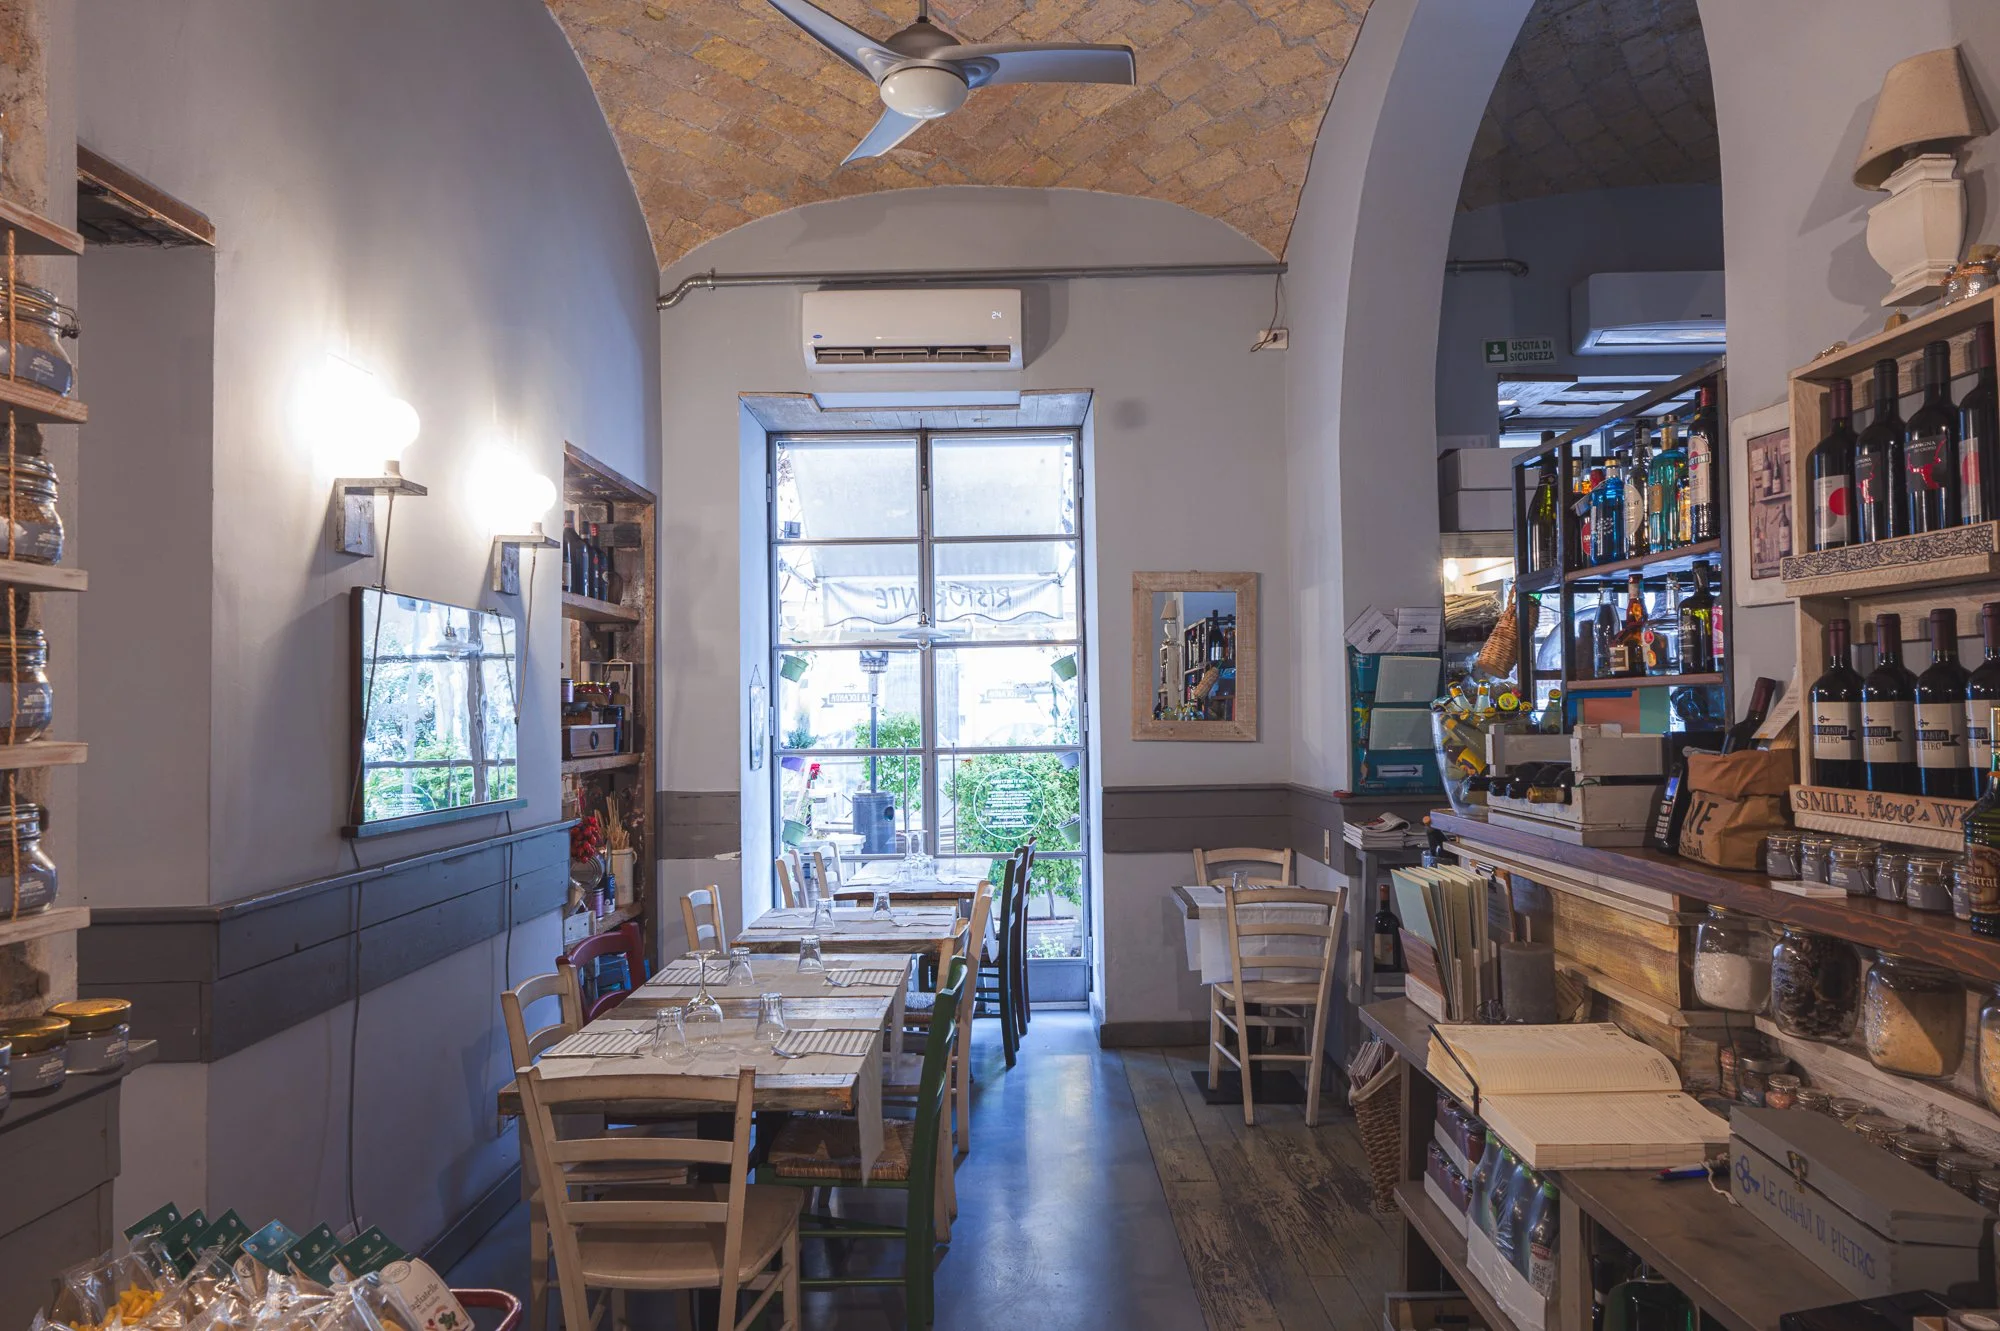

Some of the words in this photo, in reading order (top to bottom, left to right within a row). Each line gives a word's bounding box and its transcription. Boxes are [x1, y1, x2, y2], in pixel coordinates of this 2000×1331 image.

[991, 311, 1002, 319] 24
[1511, 341, 1541, 351] USCITA
[1542, 340, 1551, 350] DI
[1510, 351, 1555, 362] SICUREZZA
[1688, 453, 1709, 466] ARTINI
[1796, 790, 1864, 818] SMILE,
[1762, 1175, 1777, 1207] LE
[1779, 1189, 1813, 1235] CHIAVI
[1816, 1214, 1826, 1246] DI
[1831, 1227, 1876, 1280] PIETRO
[410, 1283, 439, 1310] agliatelle
